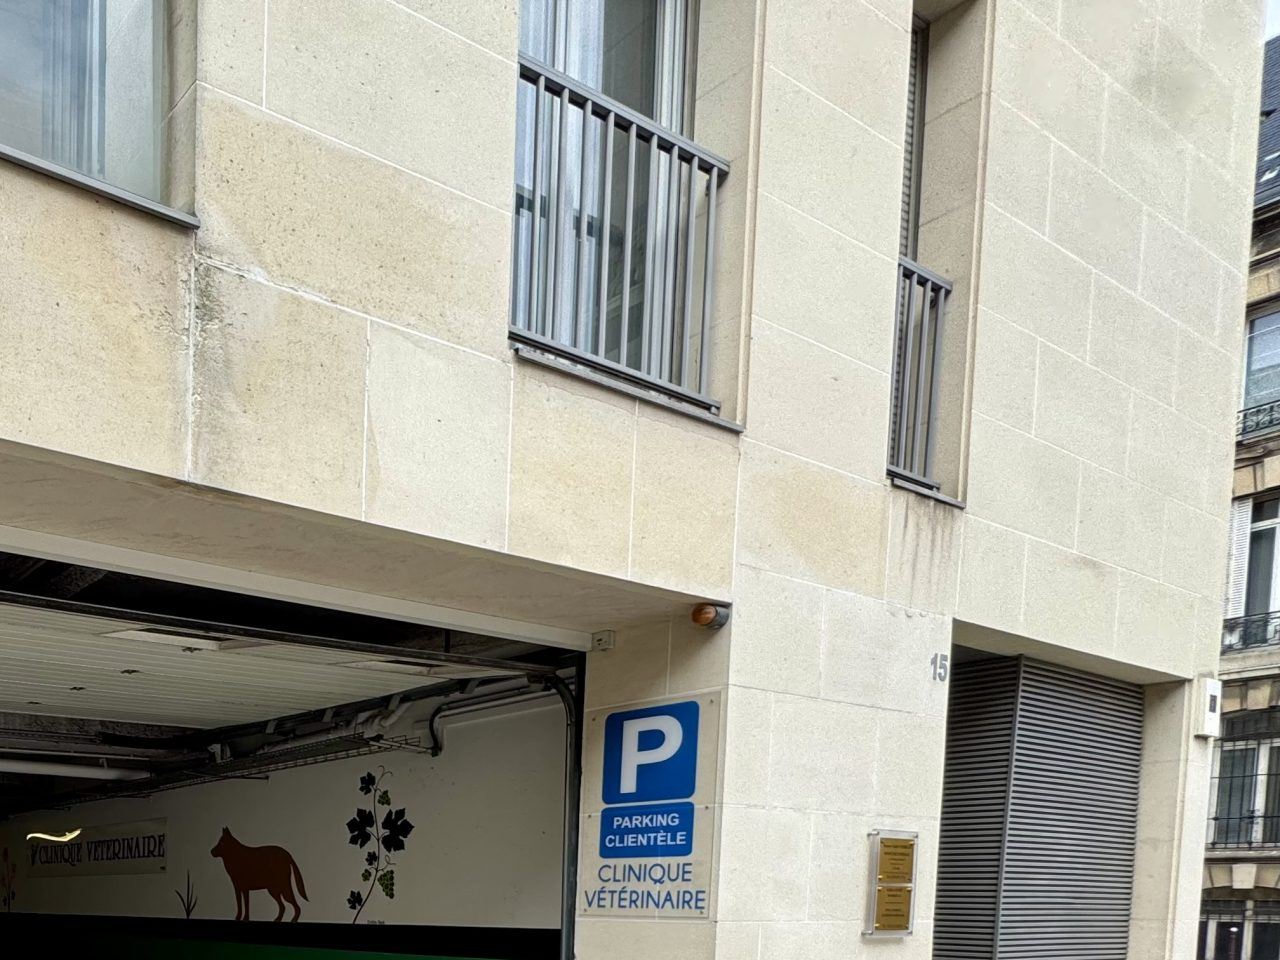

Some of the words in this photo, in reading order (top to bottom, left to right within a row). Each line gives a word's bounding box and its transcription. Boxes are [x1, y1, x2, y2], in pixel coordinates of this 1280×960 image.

[930, 652, 949, 682] 15
[620, 715, 683, 793] P
[613, 812, 680, 829] PARKING
[38, 842, 83, 867] CLINIQUE
[86, 833, 166, 862] VETERINAIRE
[605, 830, 687, 848] CLIENTÈLE
[597, 862, 693, 885] CLINIQUE
[584, 886, 707, 910] VÉTÉRINAIRE
